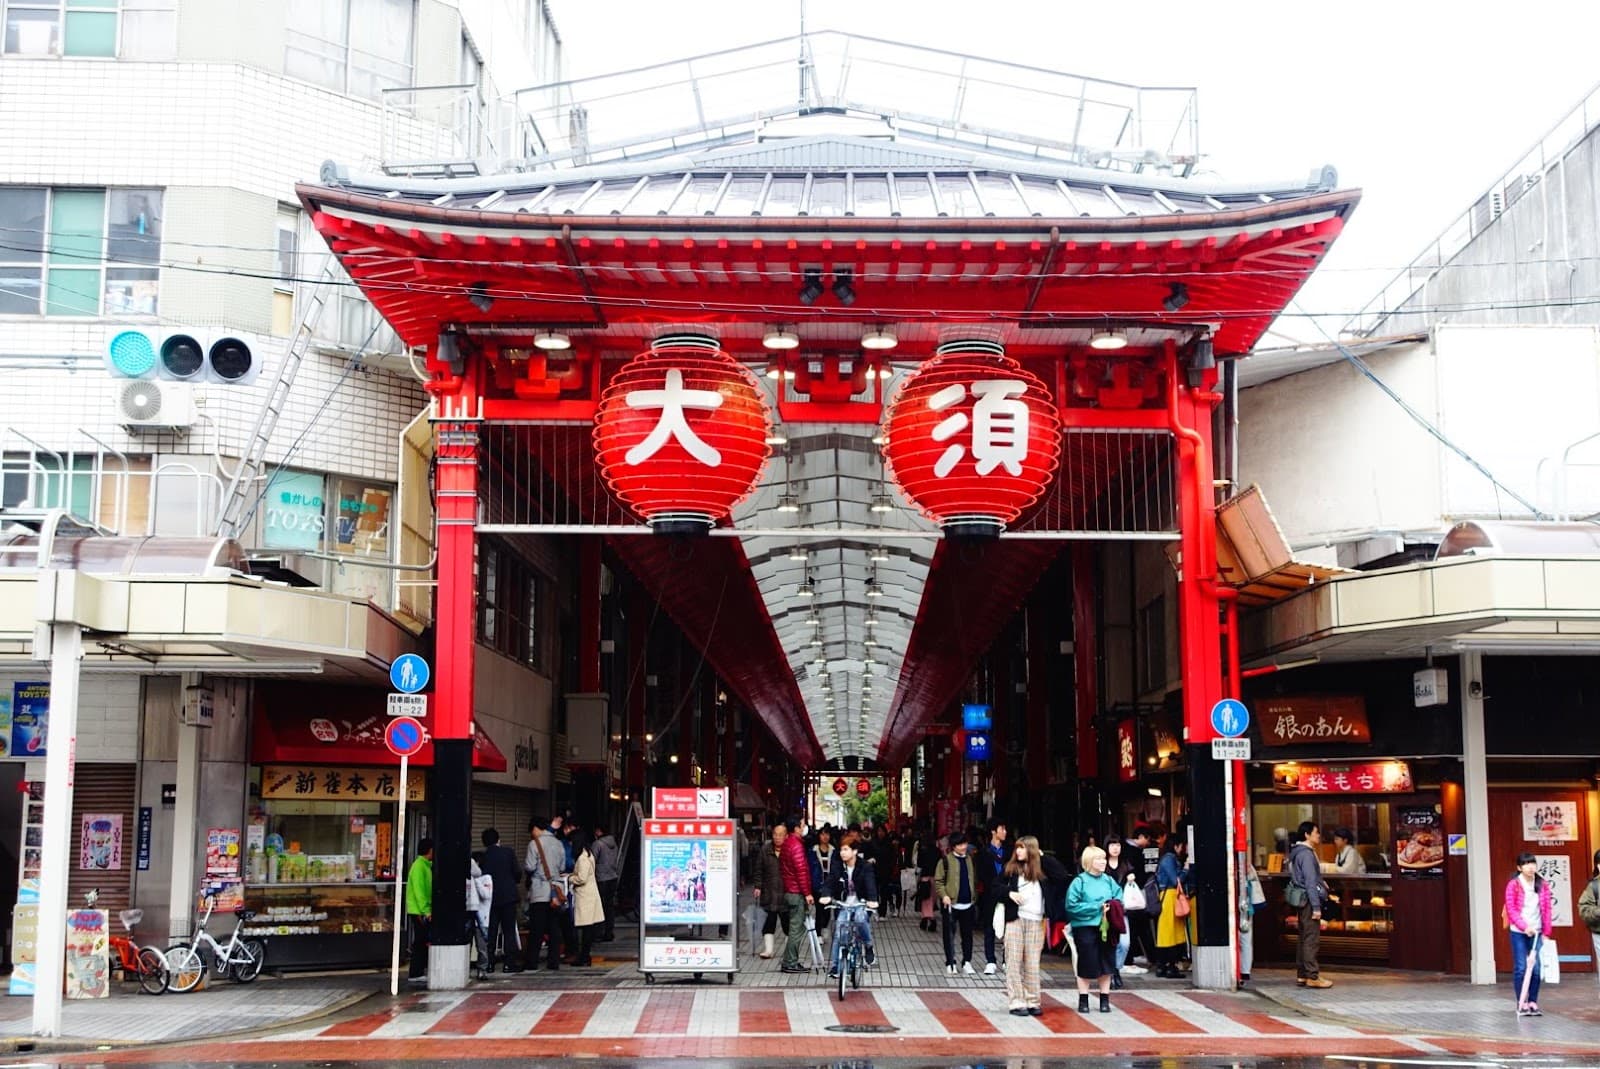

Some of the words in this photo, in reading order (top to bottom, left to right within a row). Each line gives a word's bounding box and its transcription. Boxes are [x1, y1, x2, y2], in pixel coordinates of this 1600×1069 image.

[625, 369, 723, 466] 大
[927, 380, 1029, 478] 須
[1274, 714, 1353, 739] 銀のあん
[1308, 773, 1374, 791] 桜もち
[653, 956, 721, 965] ドラゴンズ
[665, 946, 713, 955] がんばれ
